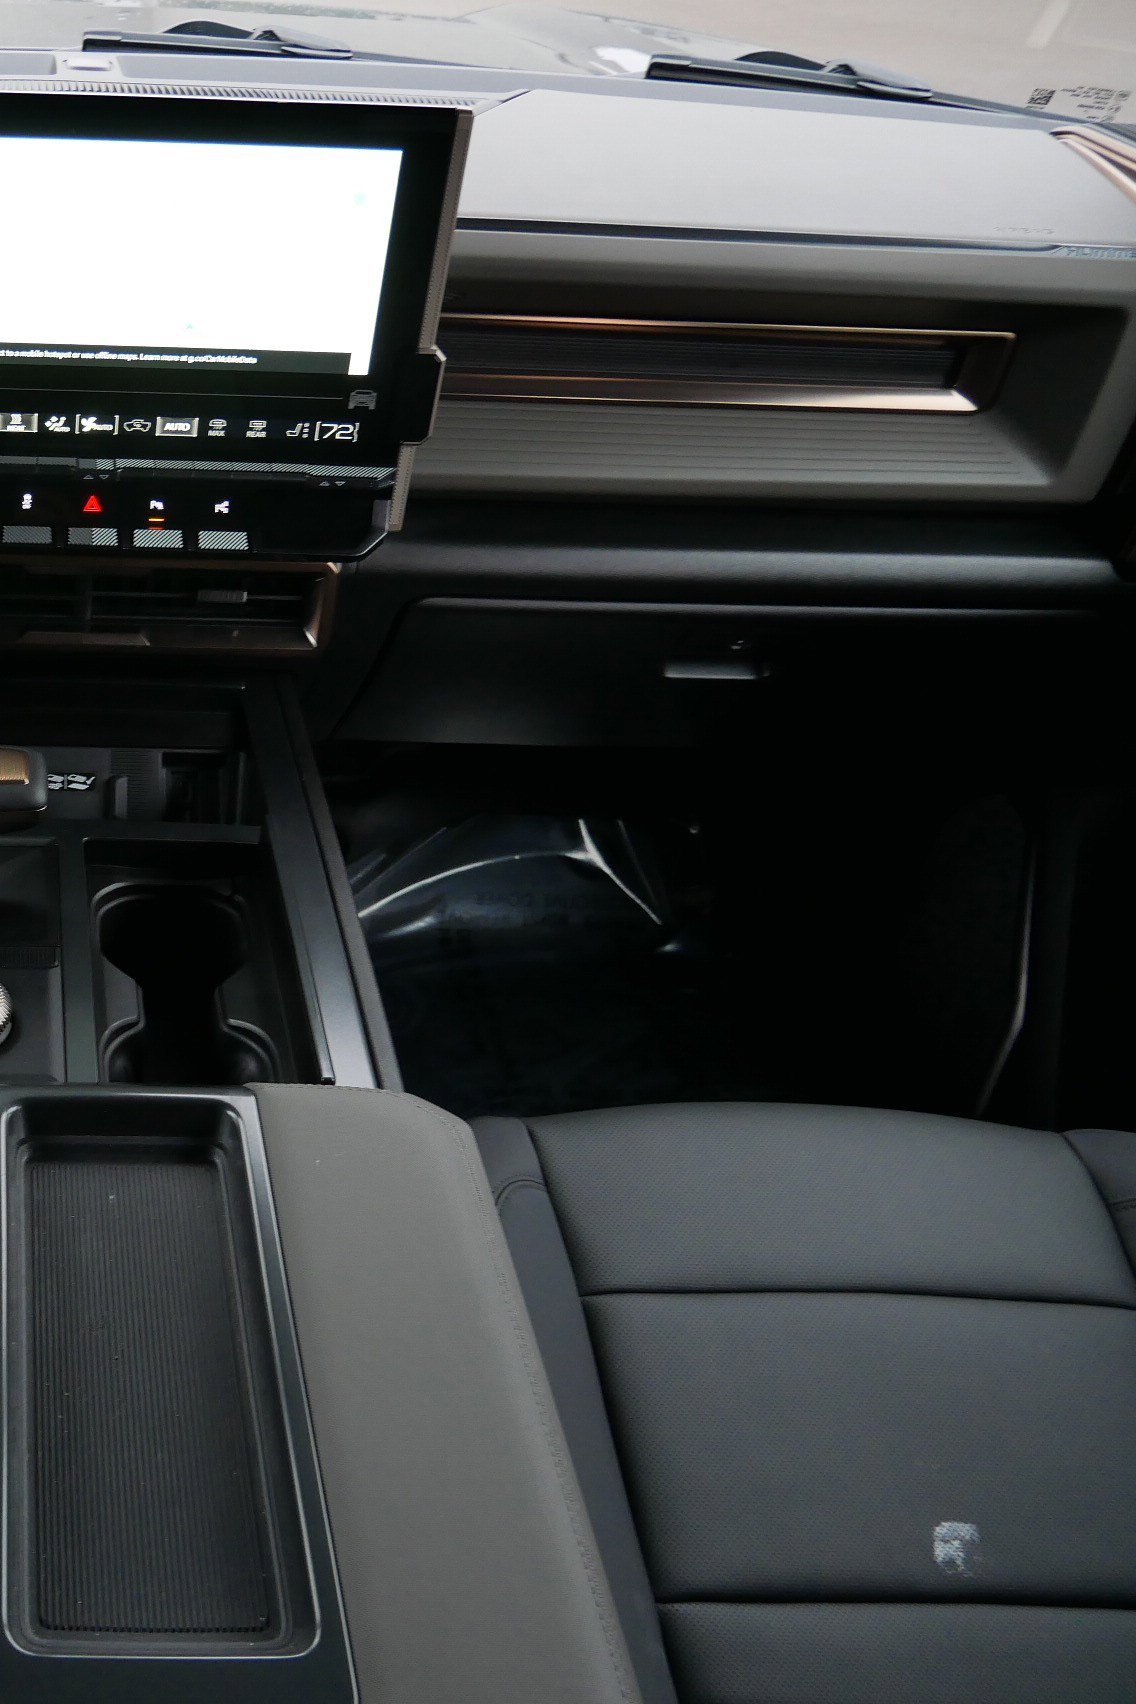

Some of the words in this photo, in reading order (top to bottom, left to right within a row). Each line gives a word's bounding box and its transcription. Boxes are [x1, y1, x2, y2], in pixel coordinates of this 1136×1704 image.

[44, 351, 71, 360] hotspot
[95, 352, 117, 360] offline
[140, 353, 160, 361] Learn
[164, 423, 191, 431] AUTO
[320, 423, 354, 440] 72
[245, 430, 267, 438] REAR
